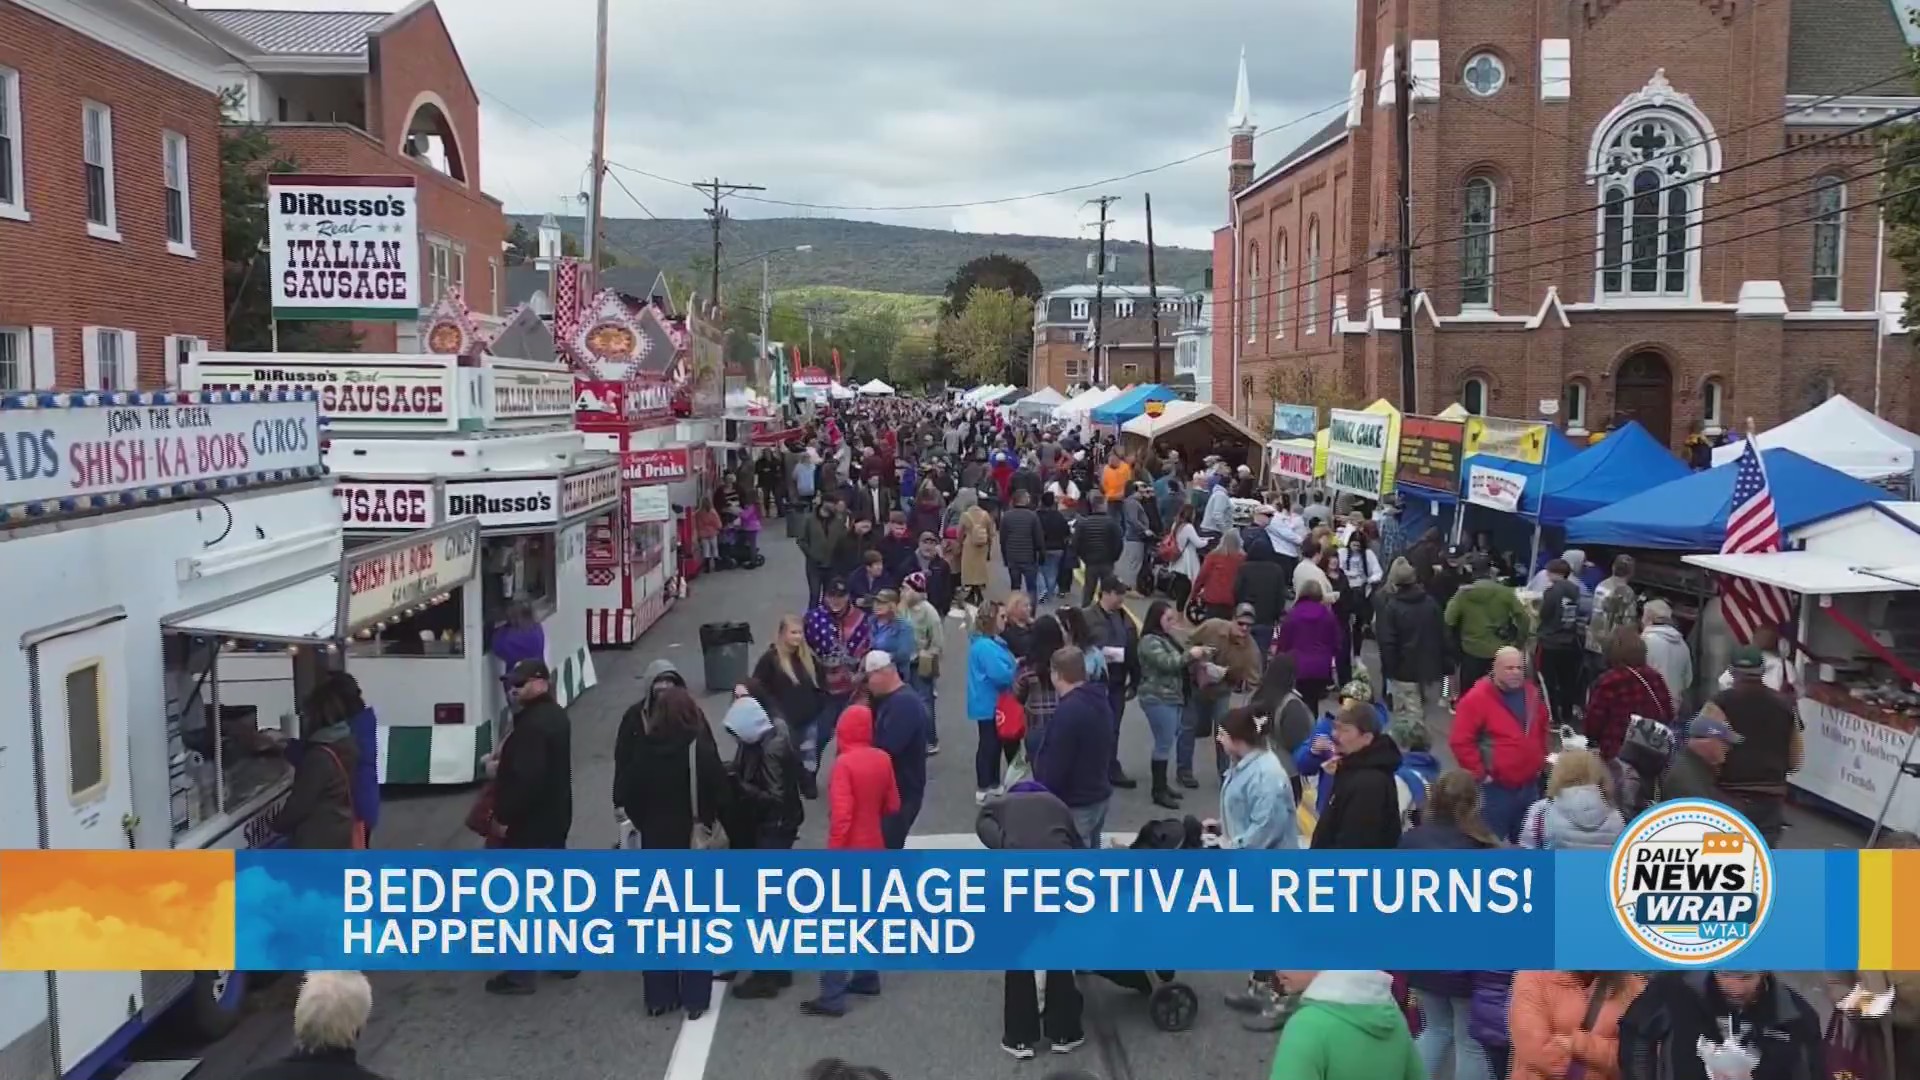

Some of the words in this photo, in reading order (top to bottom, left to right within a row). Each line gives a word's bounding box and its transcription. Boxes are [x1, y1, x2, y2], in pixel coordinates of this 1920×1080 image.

[280, 192, 406, 217] DiRusso's
[316, 219, 372, 237] Real
[287, 240, 401, 269] ITALIAN
[283, 270, 407, 300] SAUSAGE
[254, 369, 338, 382] DiRusso's
[344, 370, 379, 383] Real
[322, 385, 443, 413] SAUSAGE
[107, 408, 142, 437] JOHN
[149, 408, 170, 430] THE
[176, 407, 212, 428] GREEK
[252, 417, 309, 456] GYROS
[1356, 423, 1384, 449] CAKE
[623, 464, 642, 480] old
[645, 462, 685, 479] Drinks
[333, 489, 426, 523] USAGE
[449, 491, 552, 517] DiRusso's
[352, 557, 386, 595] SHISH
[1820, 704, 1861, 732] UNITED
[1862, 721, 1907, 746] STATES
[1821, 721, 1857, 752] Military
